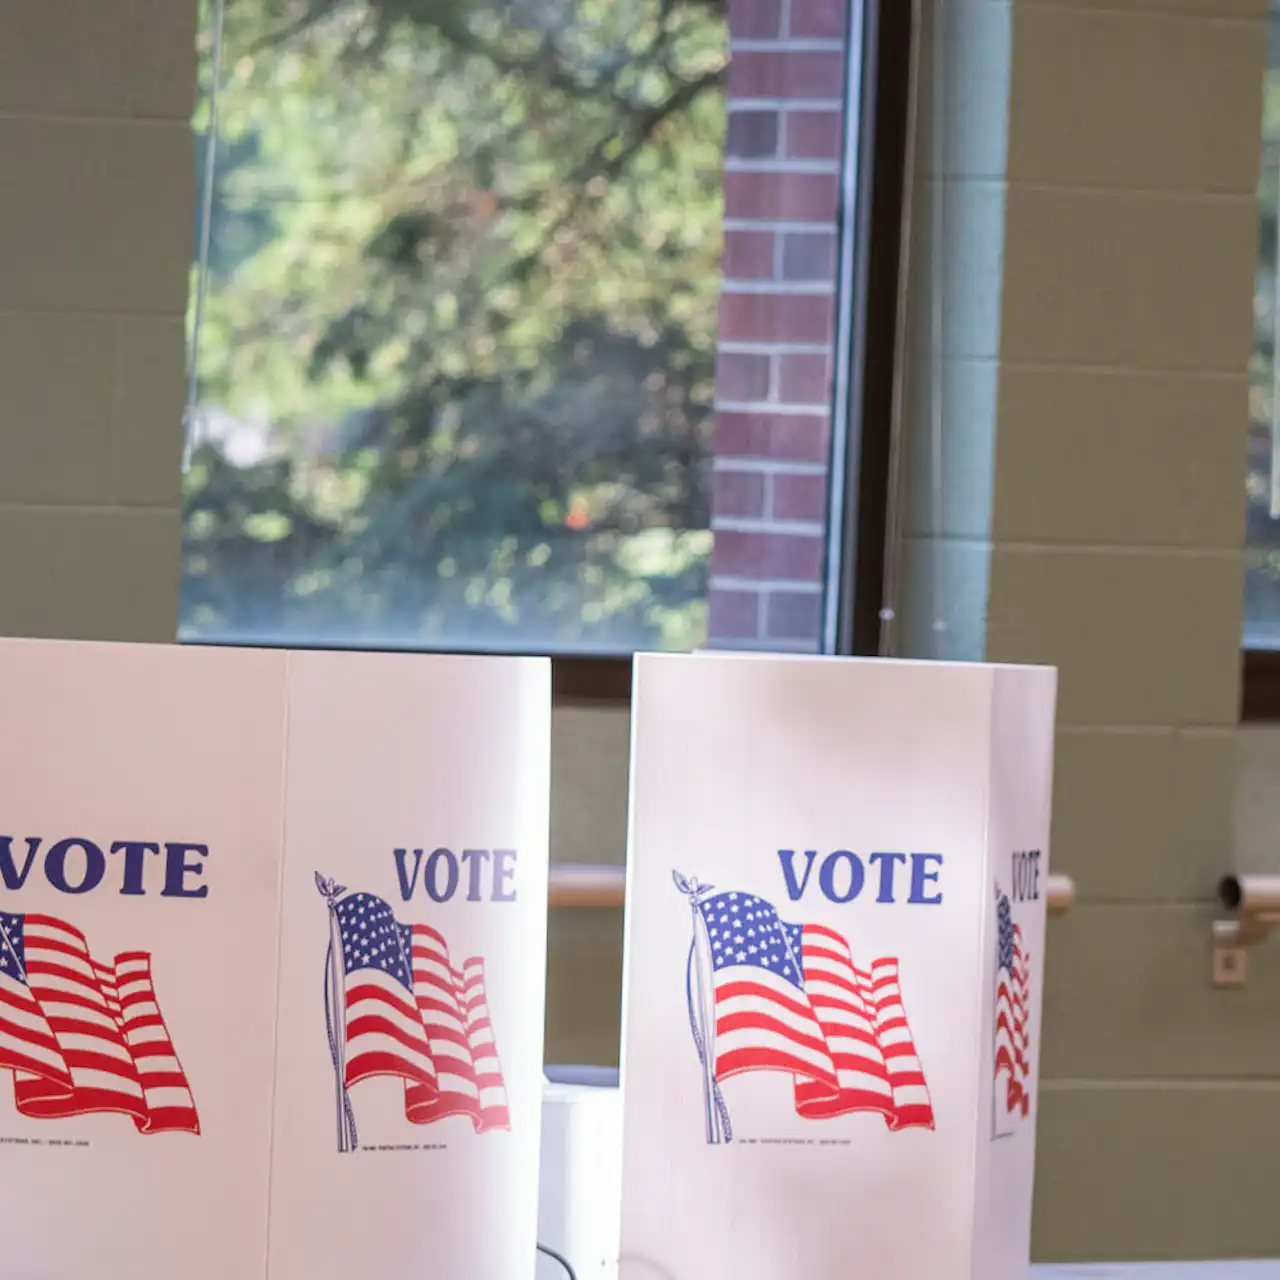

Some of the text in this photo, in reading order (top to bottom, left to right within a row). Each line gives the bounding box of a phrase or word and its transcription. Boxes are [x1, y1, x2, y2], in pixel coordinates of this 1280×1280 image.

[0, 836, 209, 898] VOTE
[393, 848, 517, 903] VOTE
[777, 849, 943, 905] VOTE
[1012, 850, 1040, 901] VOTE
